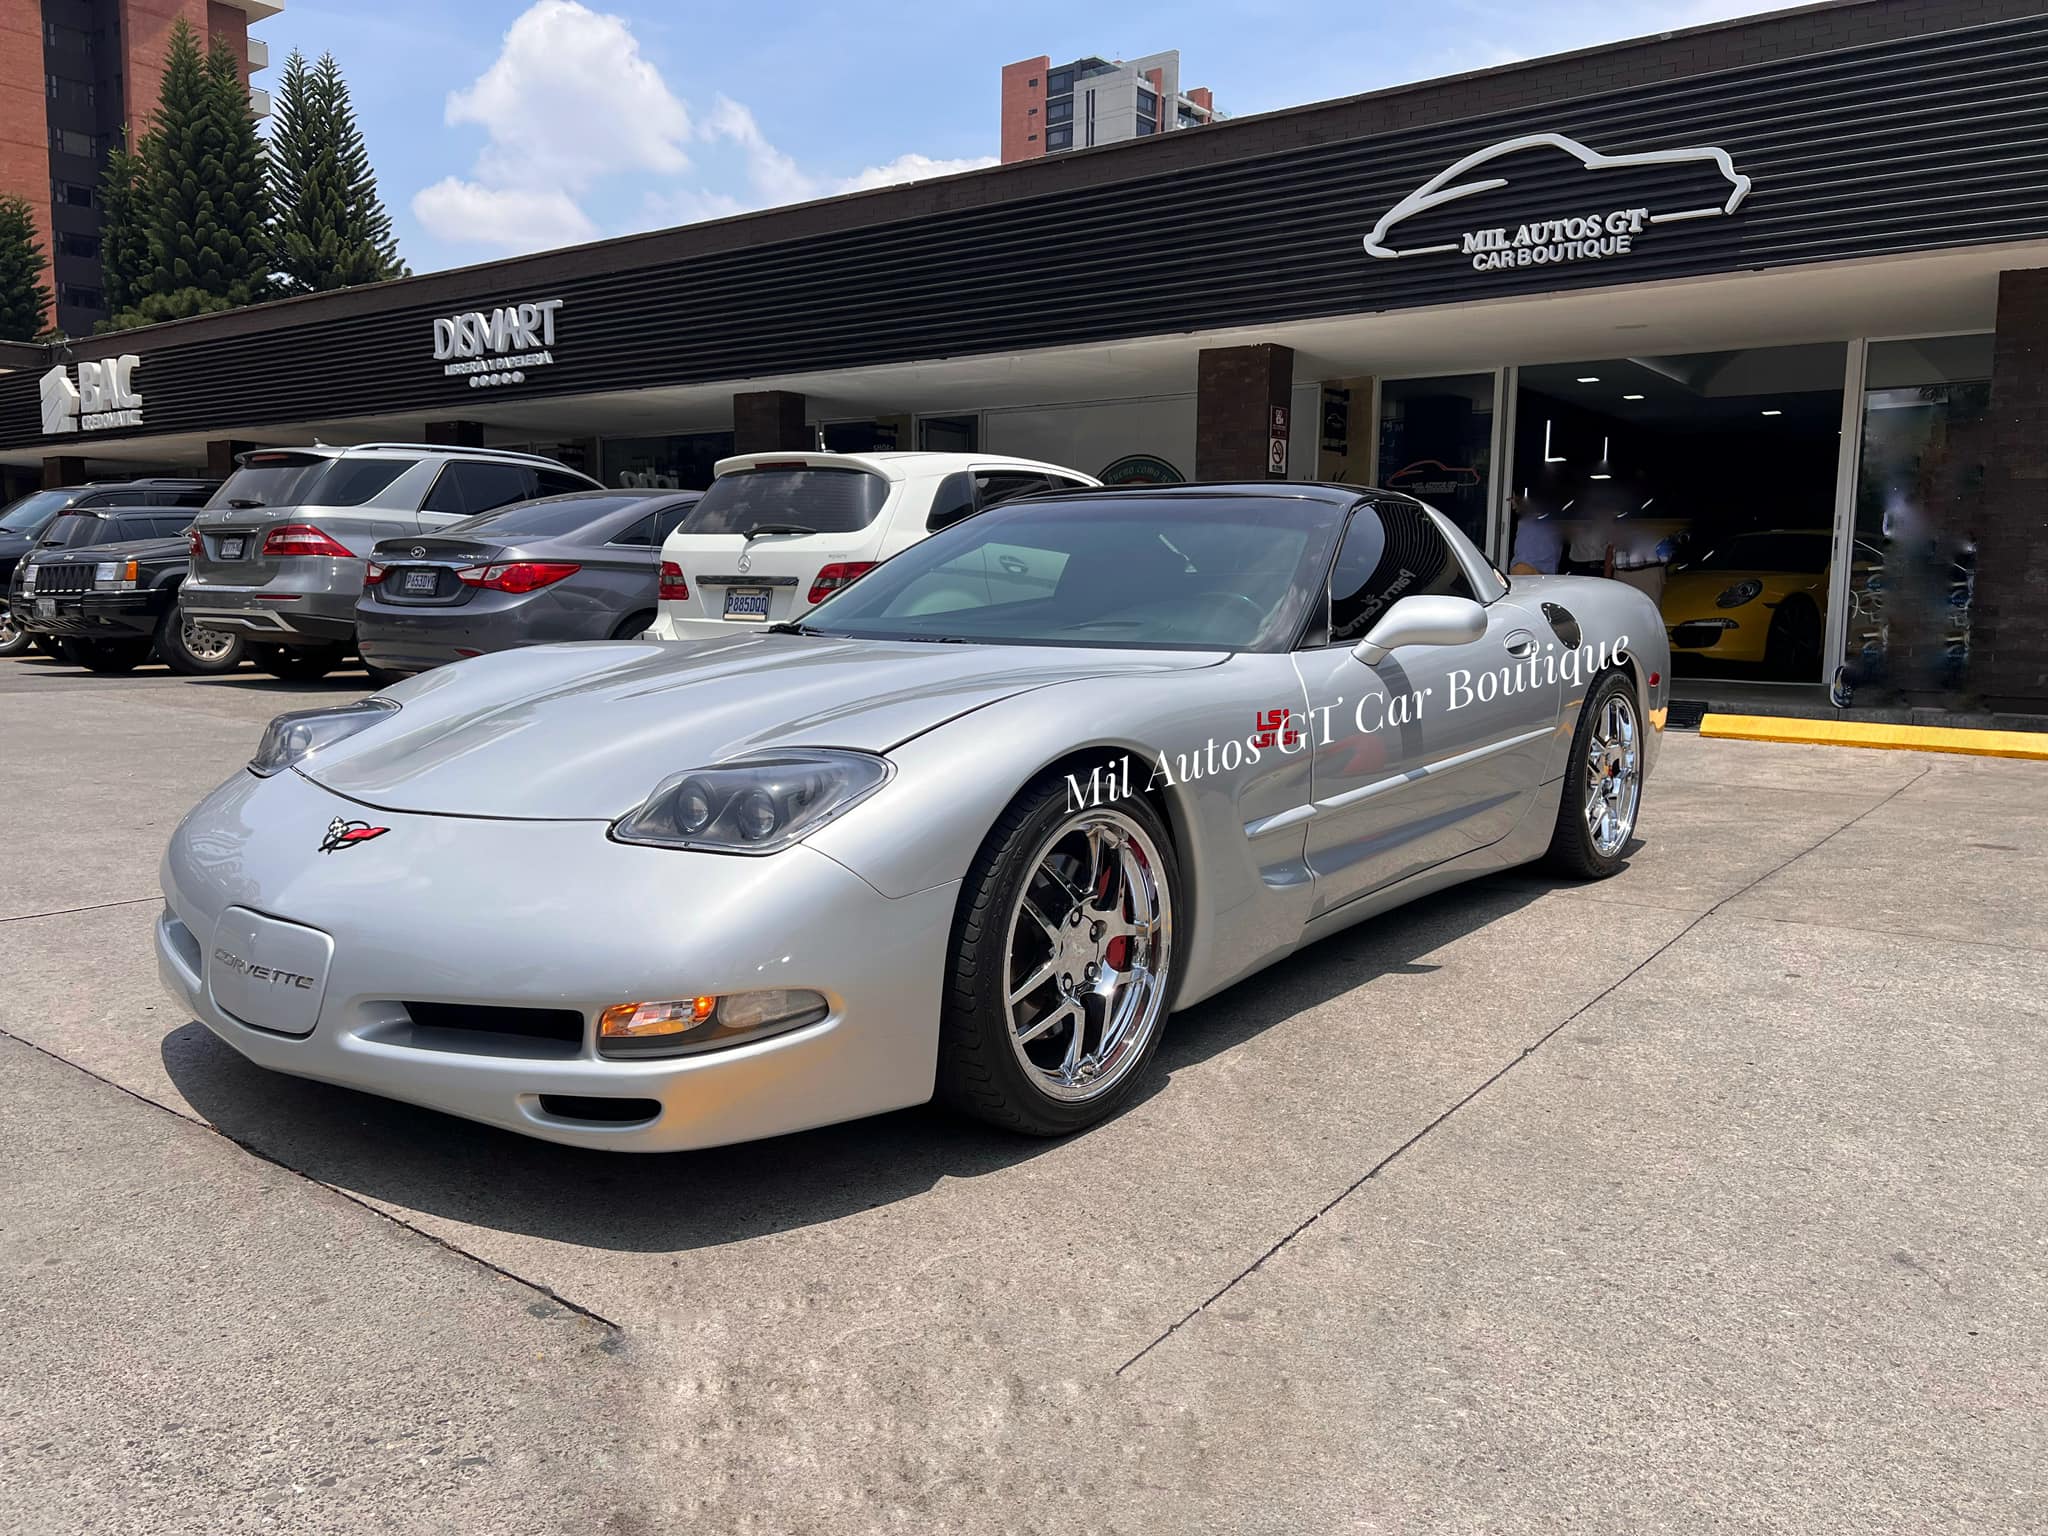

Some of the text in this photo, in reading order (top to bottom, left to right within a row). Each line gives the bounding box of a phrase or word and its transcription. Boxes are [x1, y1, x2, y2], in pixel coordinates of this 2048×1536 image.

[1461, 207, 1649, 254] MIL AUTOS GT
[1472, 235, 1634, 272] CAR BOUTIQUE
[433, 299, 563, 360] DISMART
[78, 354, 143, 413] BAC
[215, 947, 315, 990] CORVETTE
